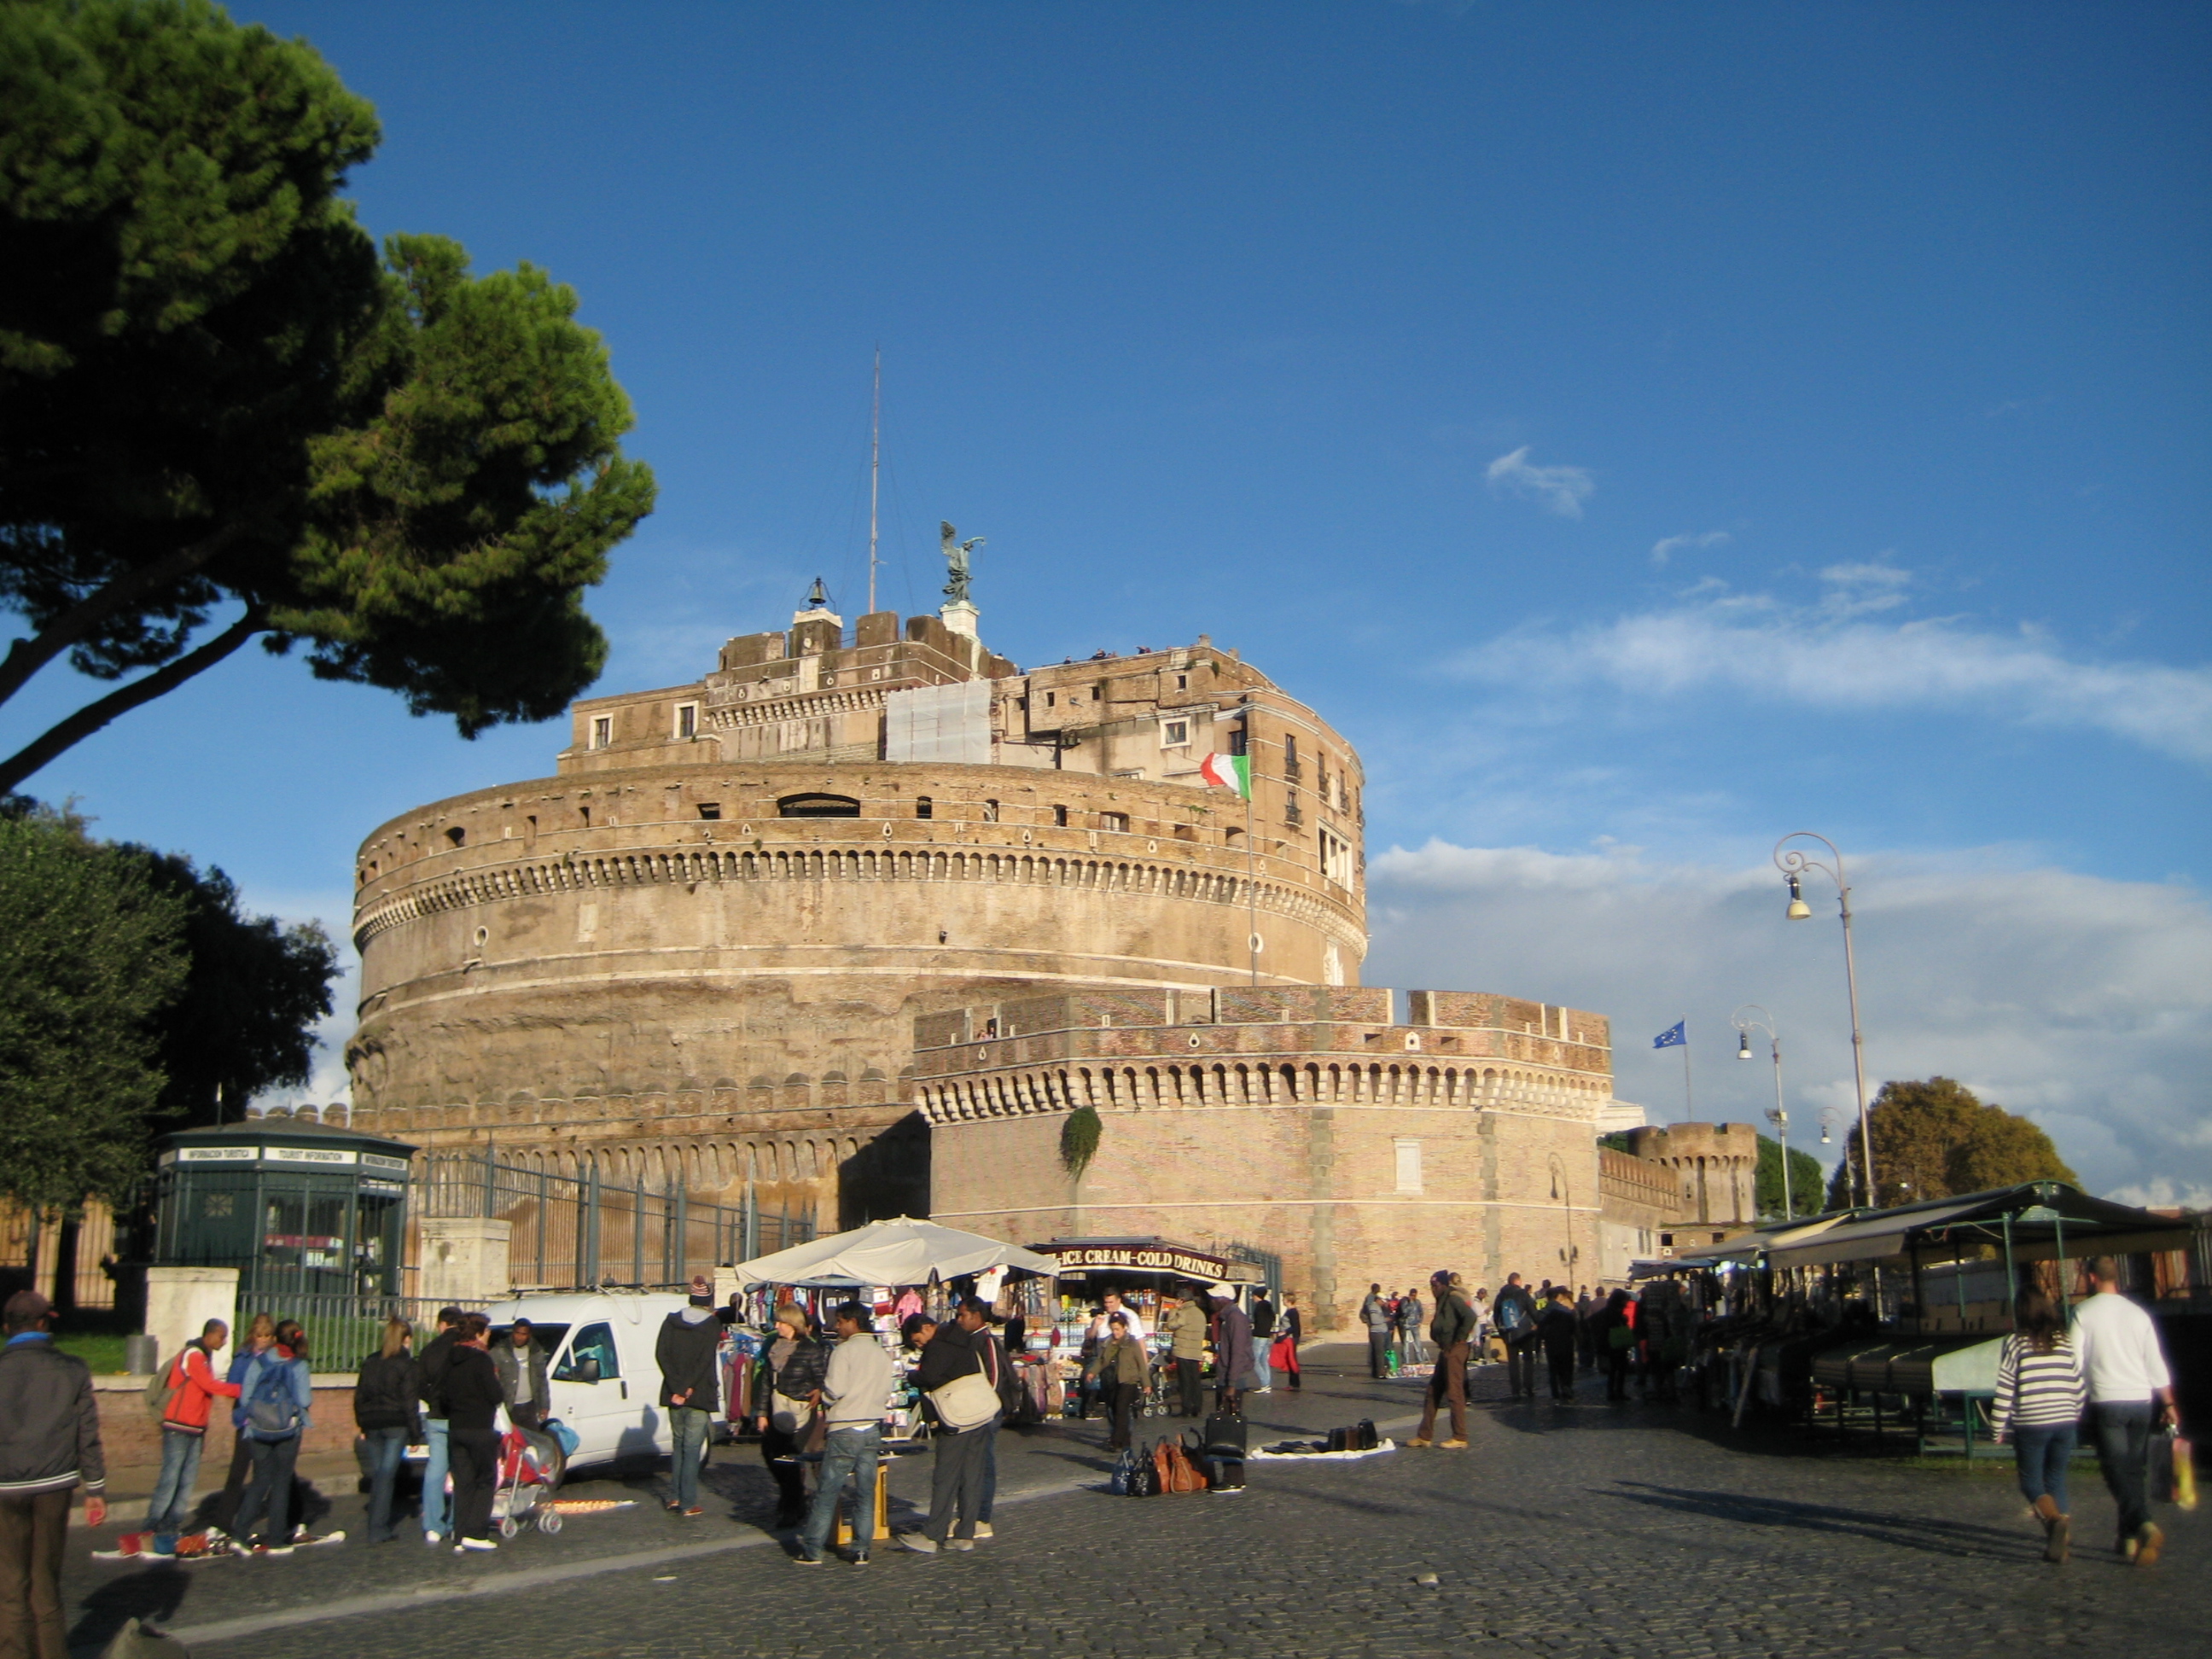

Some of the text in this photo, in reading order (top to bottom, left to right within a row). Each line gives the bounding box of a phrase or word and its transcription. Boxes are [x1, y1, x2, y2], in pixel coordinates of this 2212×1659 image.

[279, 1150, 343, 1161] TOURIST INFORMATION
[1174, 1254, 1224, 1278] DRINKS
